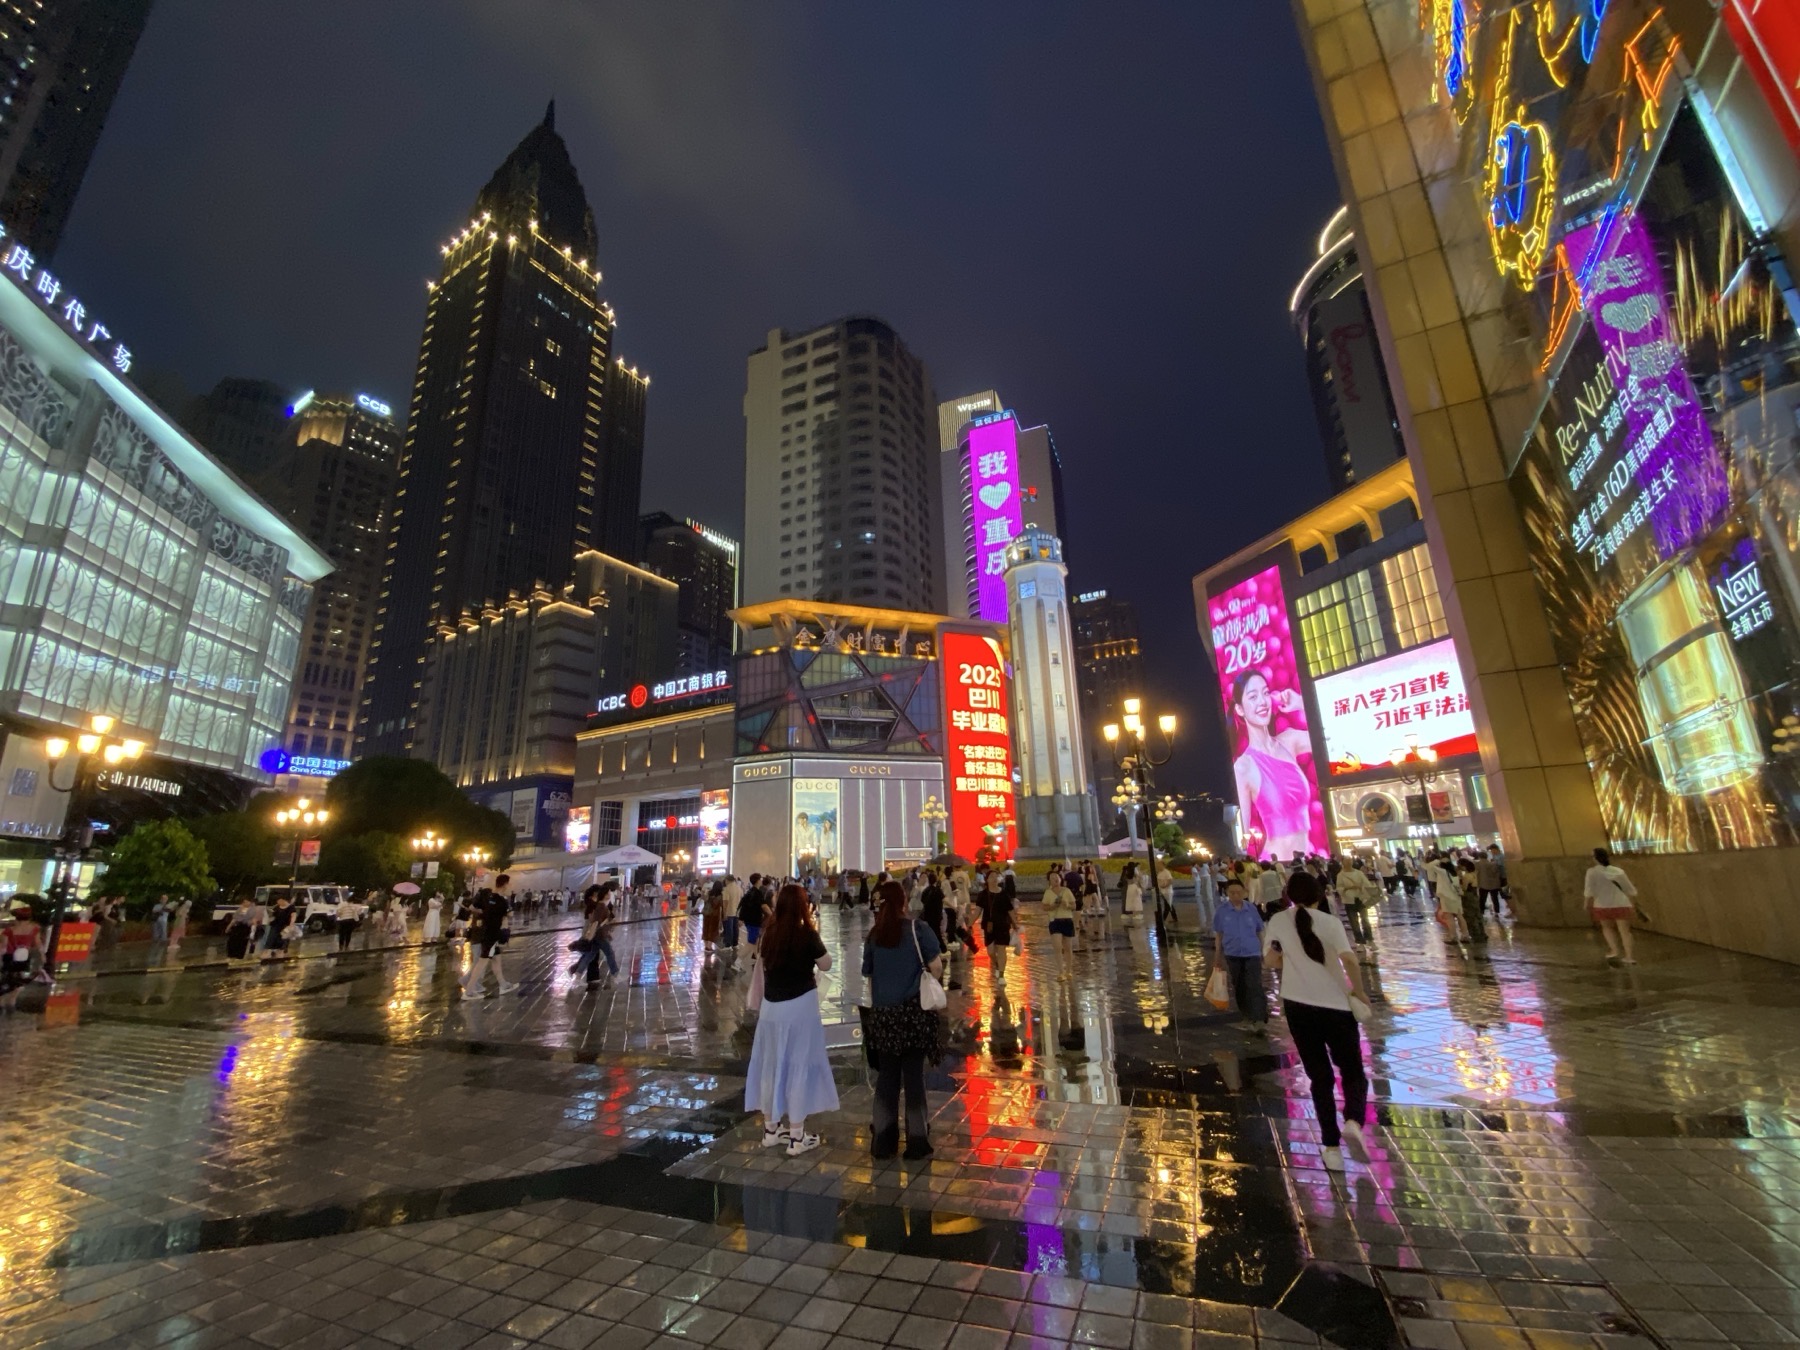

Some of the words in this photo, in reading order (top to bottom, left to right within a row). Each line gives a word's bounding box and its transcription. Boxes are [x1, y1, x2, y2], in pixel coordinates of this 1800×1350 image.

[0, 224, 133, 373] 庆时代广场
[358, 395, 390, 415] CCB
[957, 399, 991, 412] WESTIN
[978, 451, 1008, 478] 我
[1716, 567, 1760, 613] New
[1731, 601, 1773, 640] 全新上市
[653, 670, 727, 699] 中国工商银行
[959, 663, 1001, 687] 2025
[597, 693, 627, 712] ICBC
[1333, 671, 1450, 717] 深入学习宣传
[744, 765, 783, 778] GUCCI
[849, 765, 891, 775] GUCCI
[795, 781, 838, 791] GUCCI
